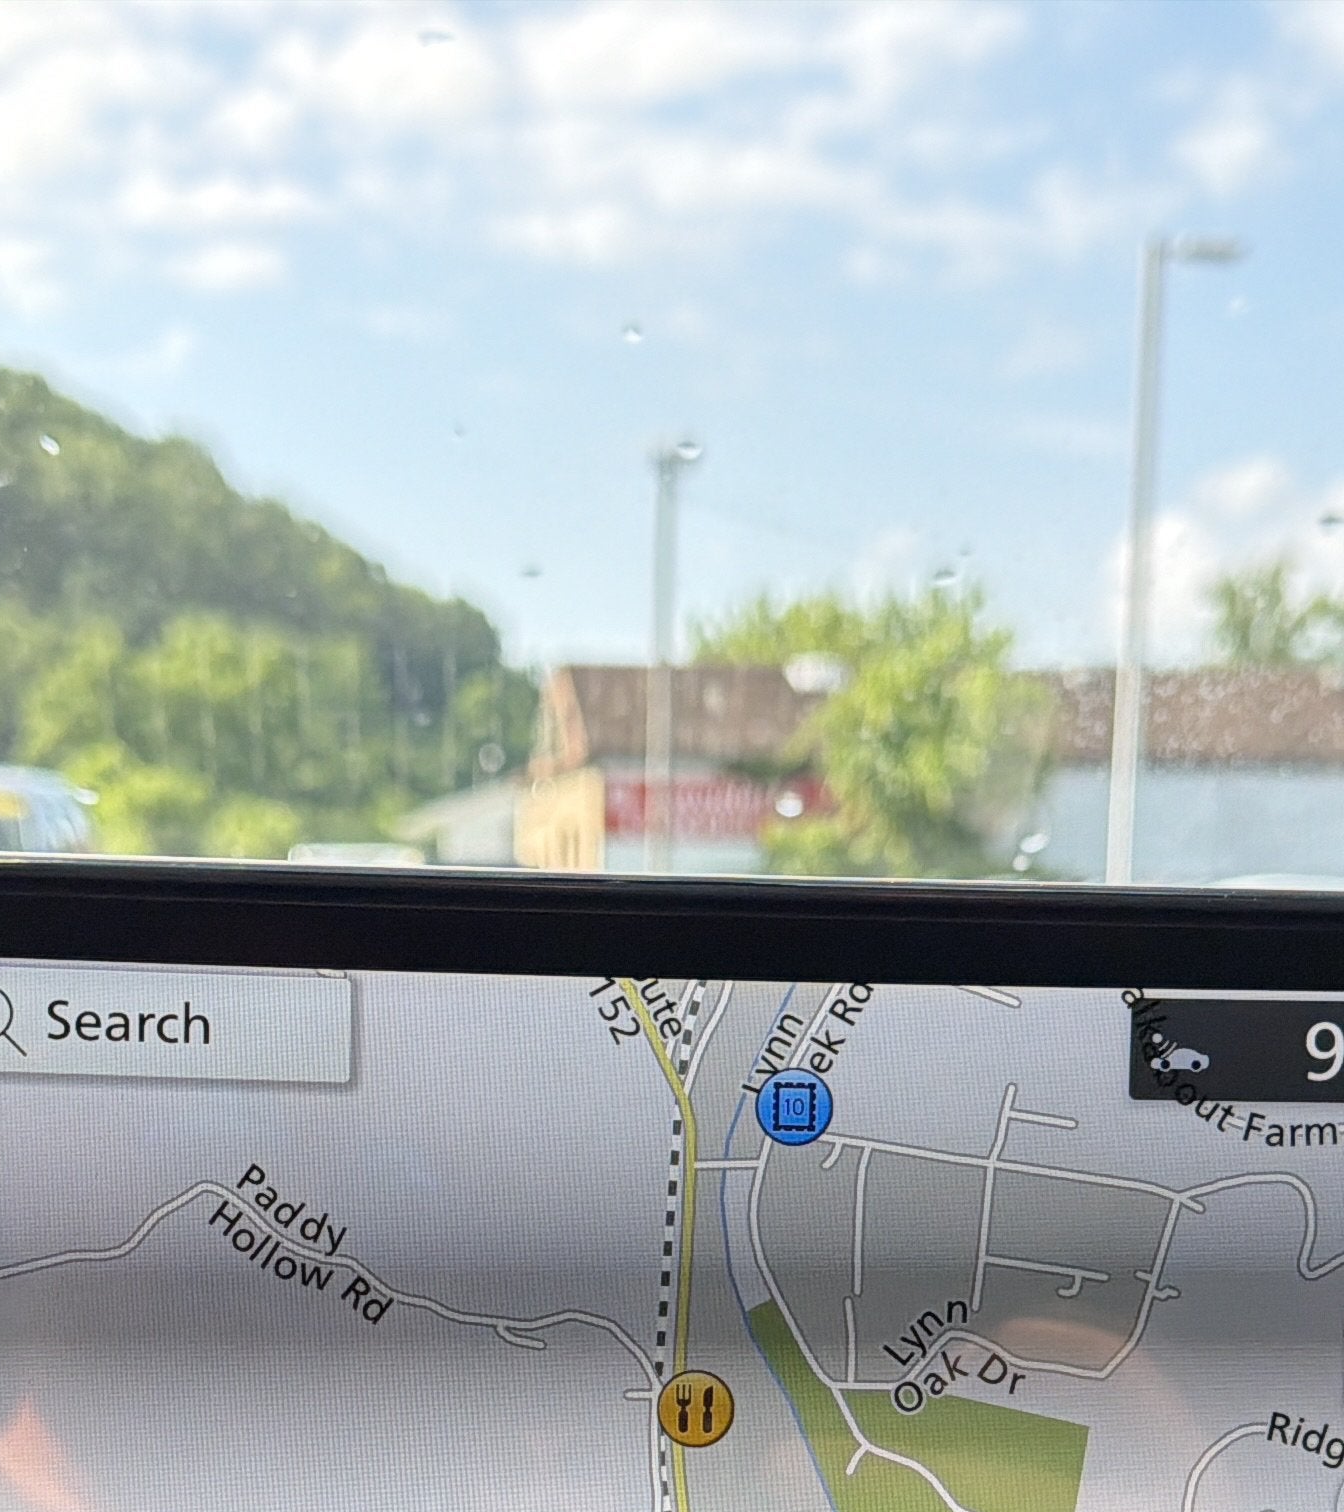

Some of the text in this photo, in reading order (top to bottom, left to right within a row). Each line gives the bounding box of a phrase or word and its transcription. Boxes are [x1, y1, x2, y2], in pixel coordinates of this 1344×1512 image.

[47, 1000, 211, 1045] Search
[588, 976, 640, 1045] 152
[1242, 1111, 1338, 1148] Farm
[235, 1164, 348, 1256] Paddy
[208, 1201, 395, 1326] Hollow Rd
[882, 1299, 969, 1367] Lynn
[893, 1351, 1026, 1413] Oak Dr
